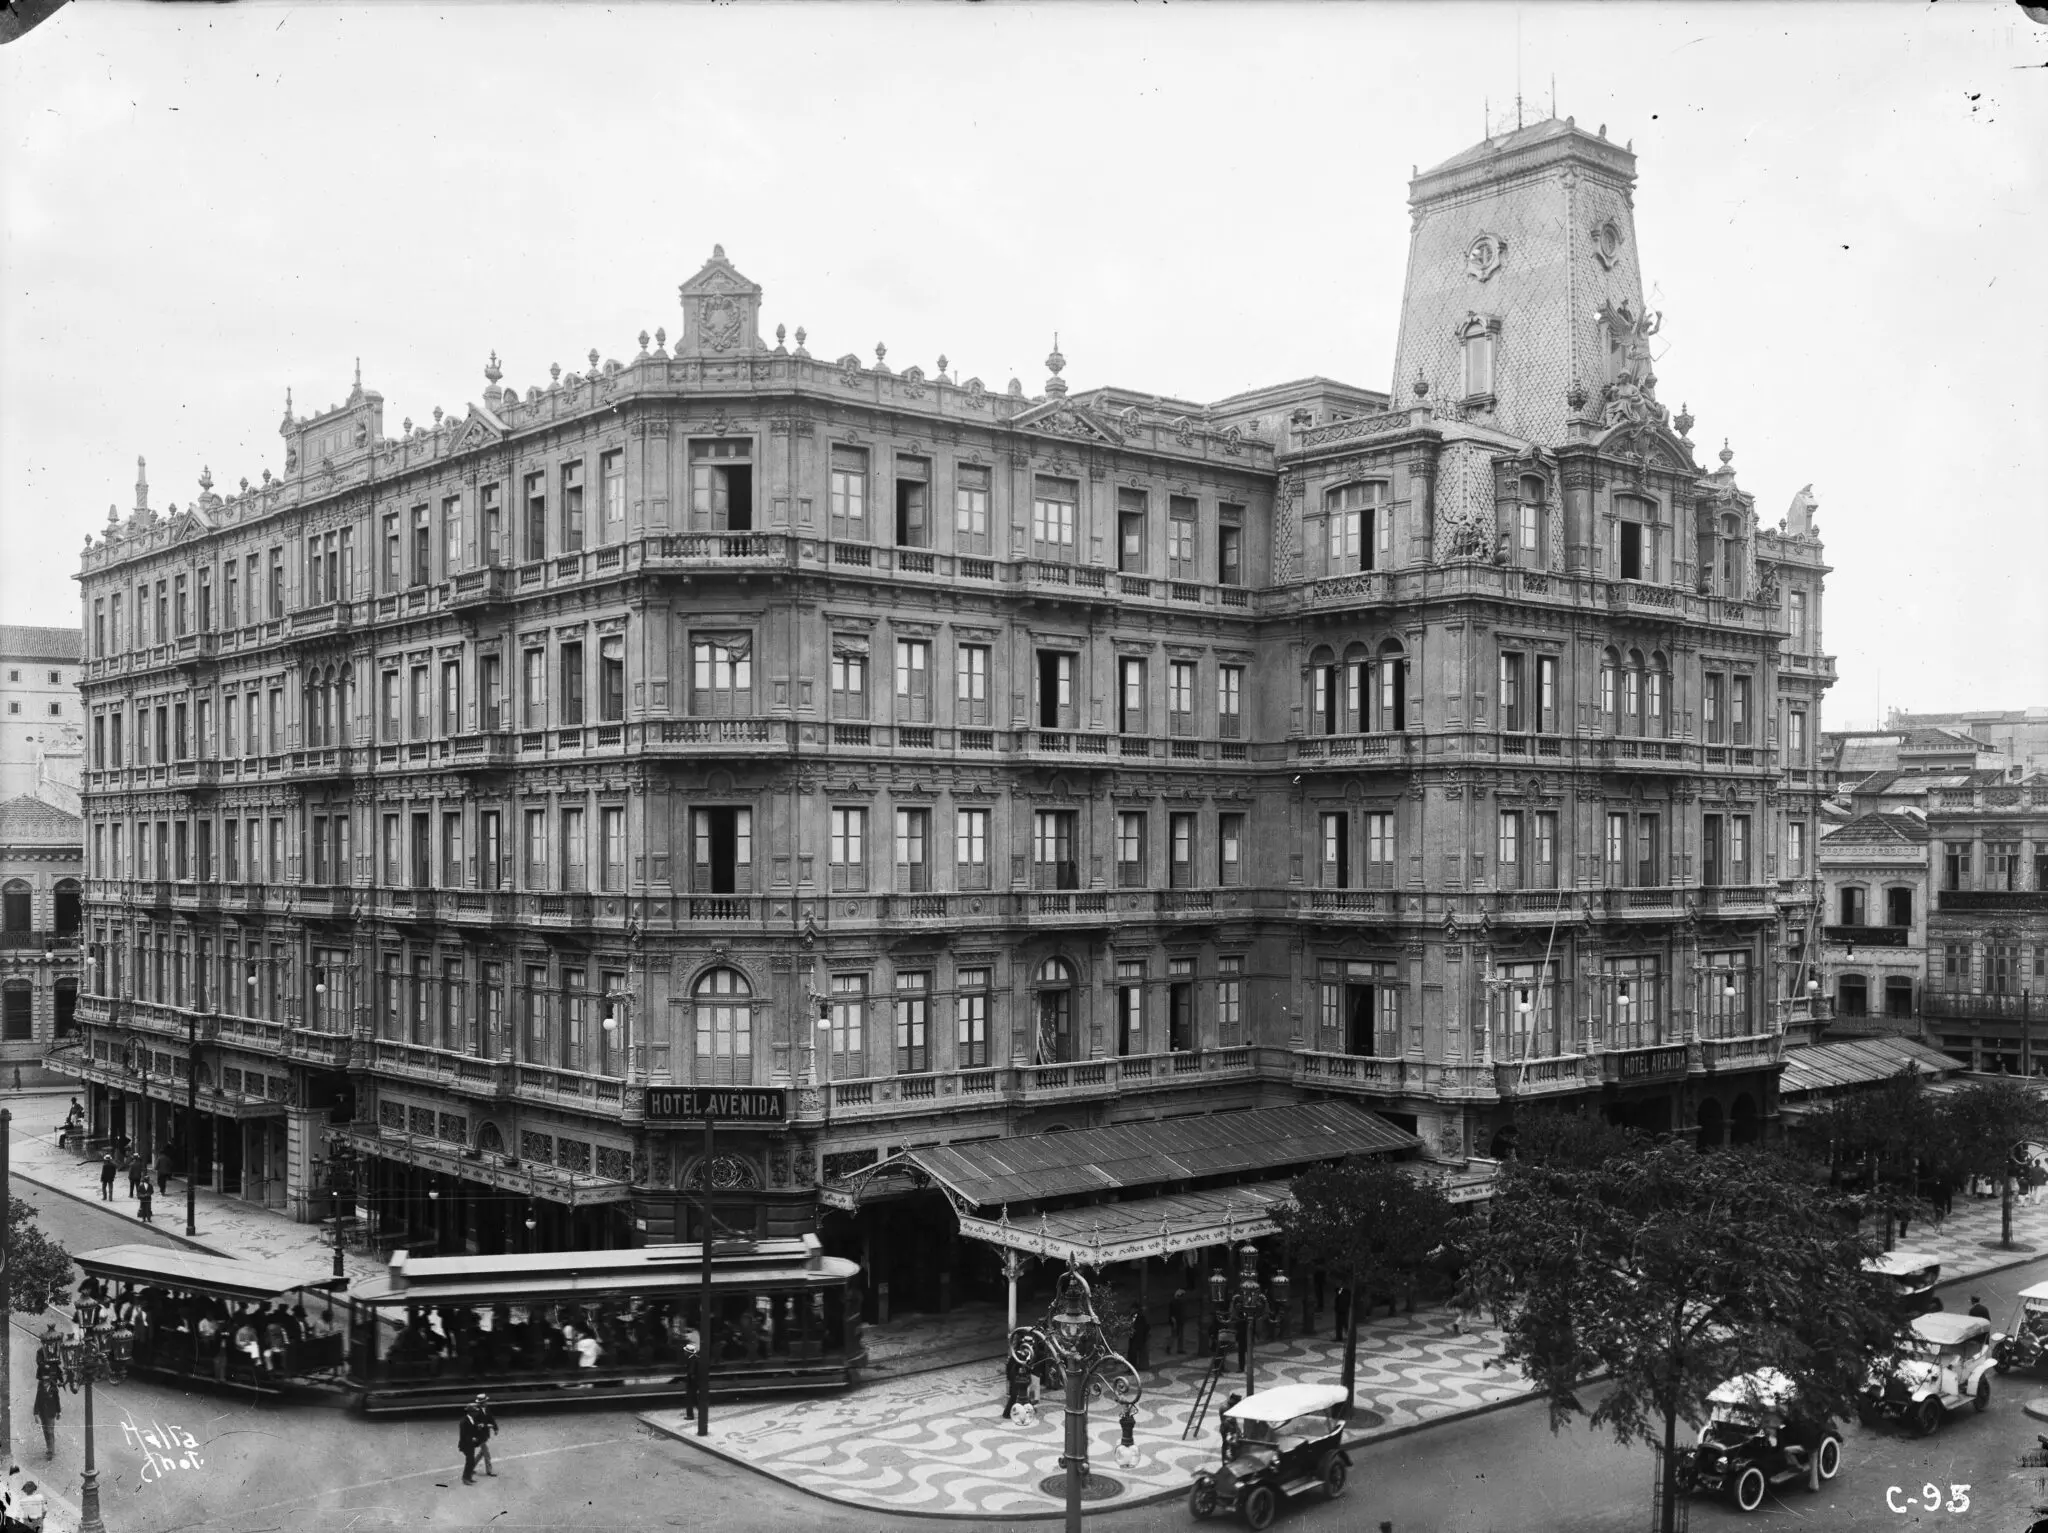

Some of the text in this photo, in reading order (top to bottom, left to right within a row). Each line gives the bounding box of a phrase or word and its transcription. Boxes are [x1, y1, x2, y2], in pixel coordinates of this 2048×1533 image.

[1624, 1051, 1686, 1075] HOTEL AVENIDA
[652, 1093, 780, 1116] HOTEL AVENIDA
